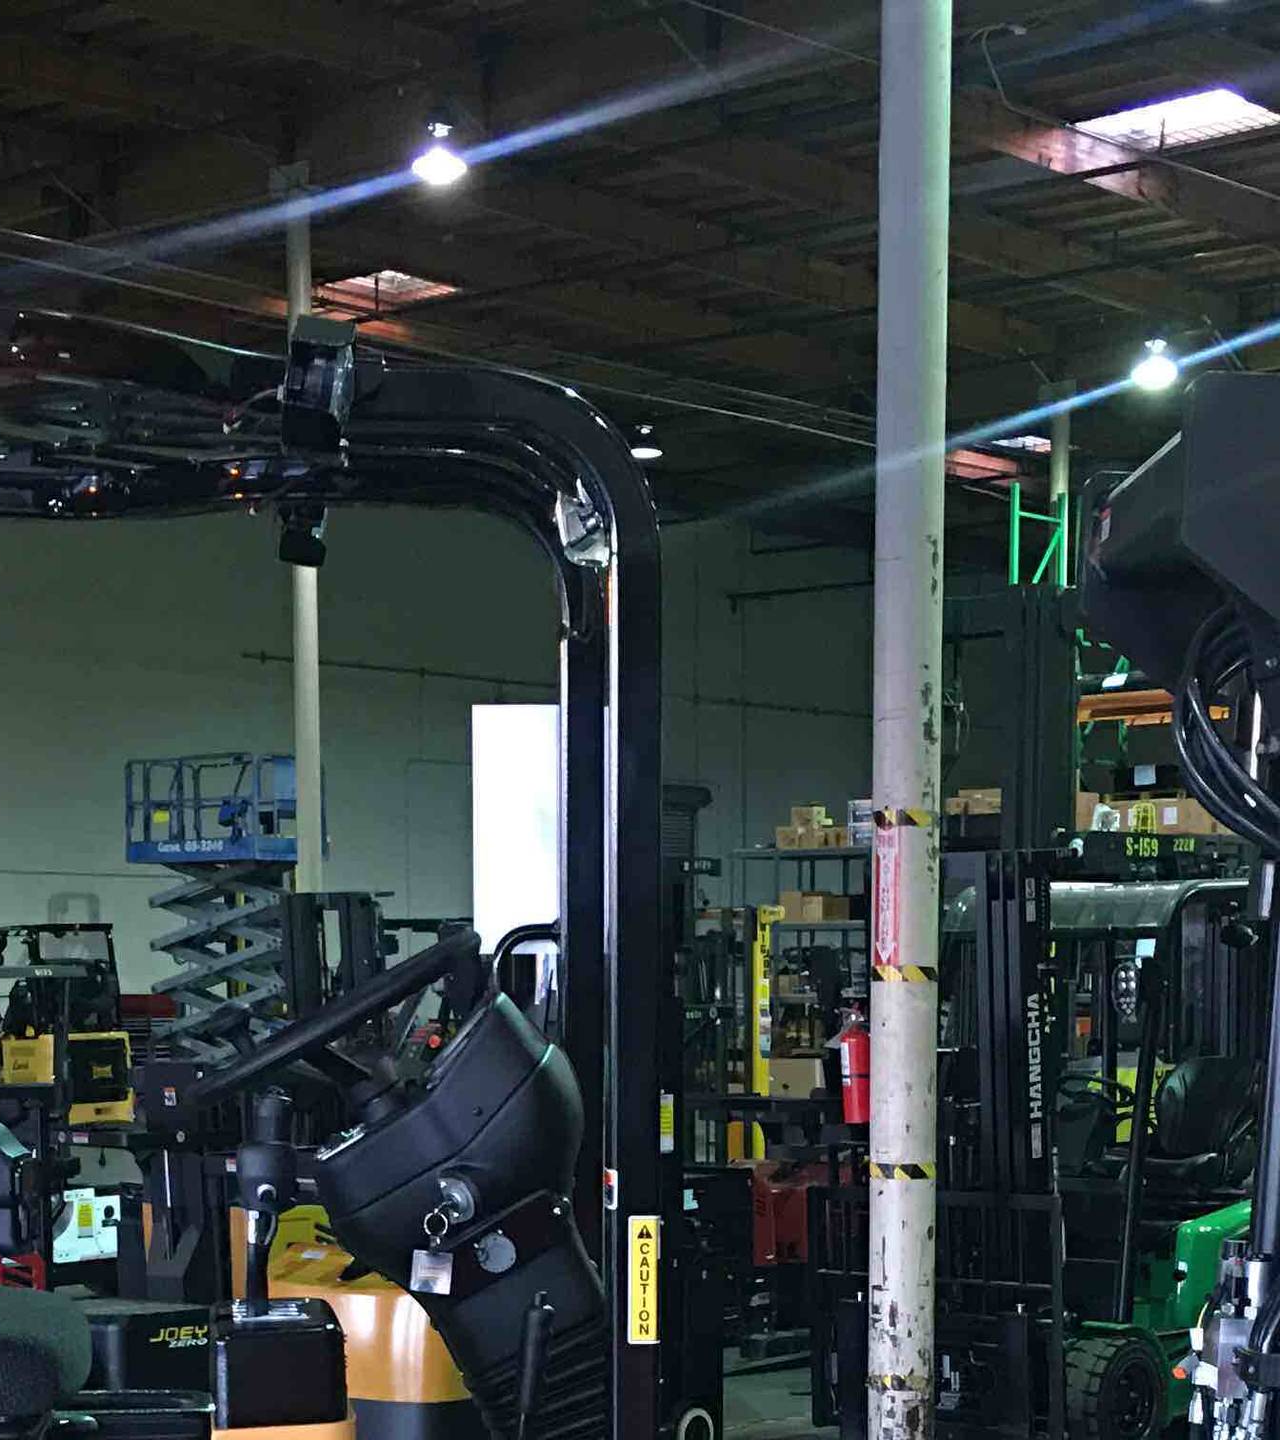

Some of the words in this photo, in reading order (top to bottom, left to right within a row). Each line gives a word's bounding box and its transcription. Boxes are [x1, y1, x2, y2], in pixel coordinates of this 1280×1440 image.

[1125, 836, 1159, 858] S-159
[1027, 992, 1043, 1120] HANGCHA
[638, 1242, 651, 1335] CAUTION
[149, 1325, 208, 1342] JOEY
[168, 1337, 209, 1348] ZERO
